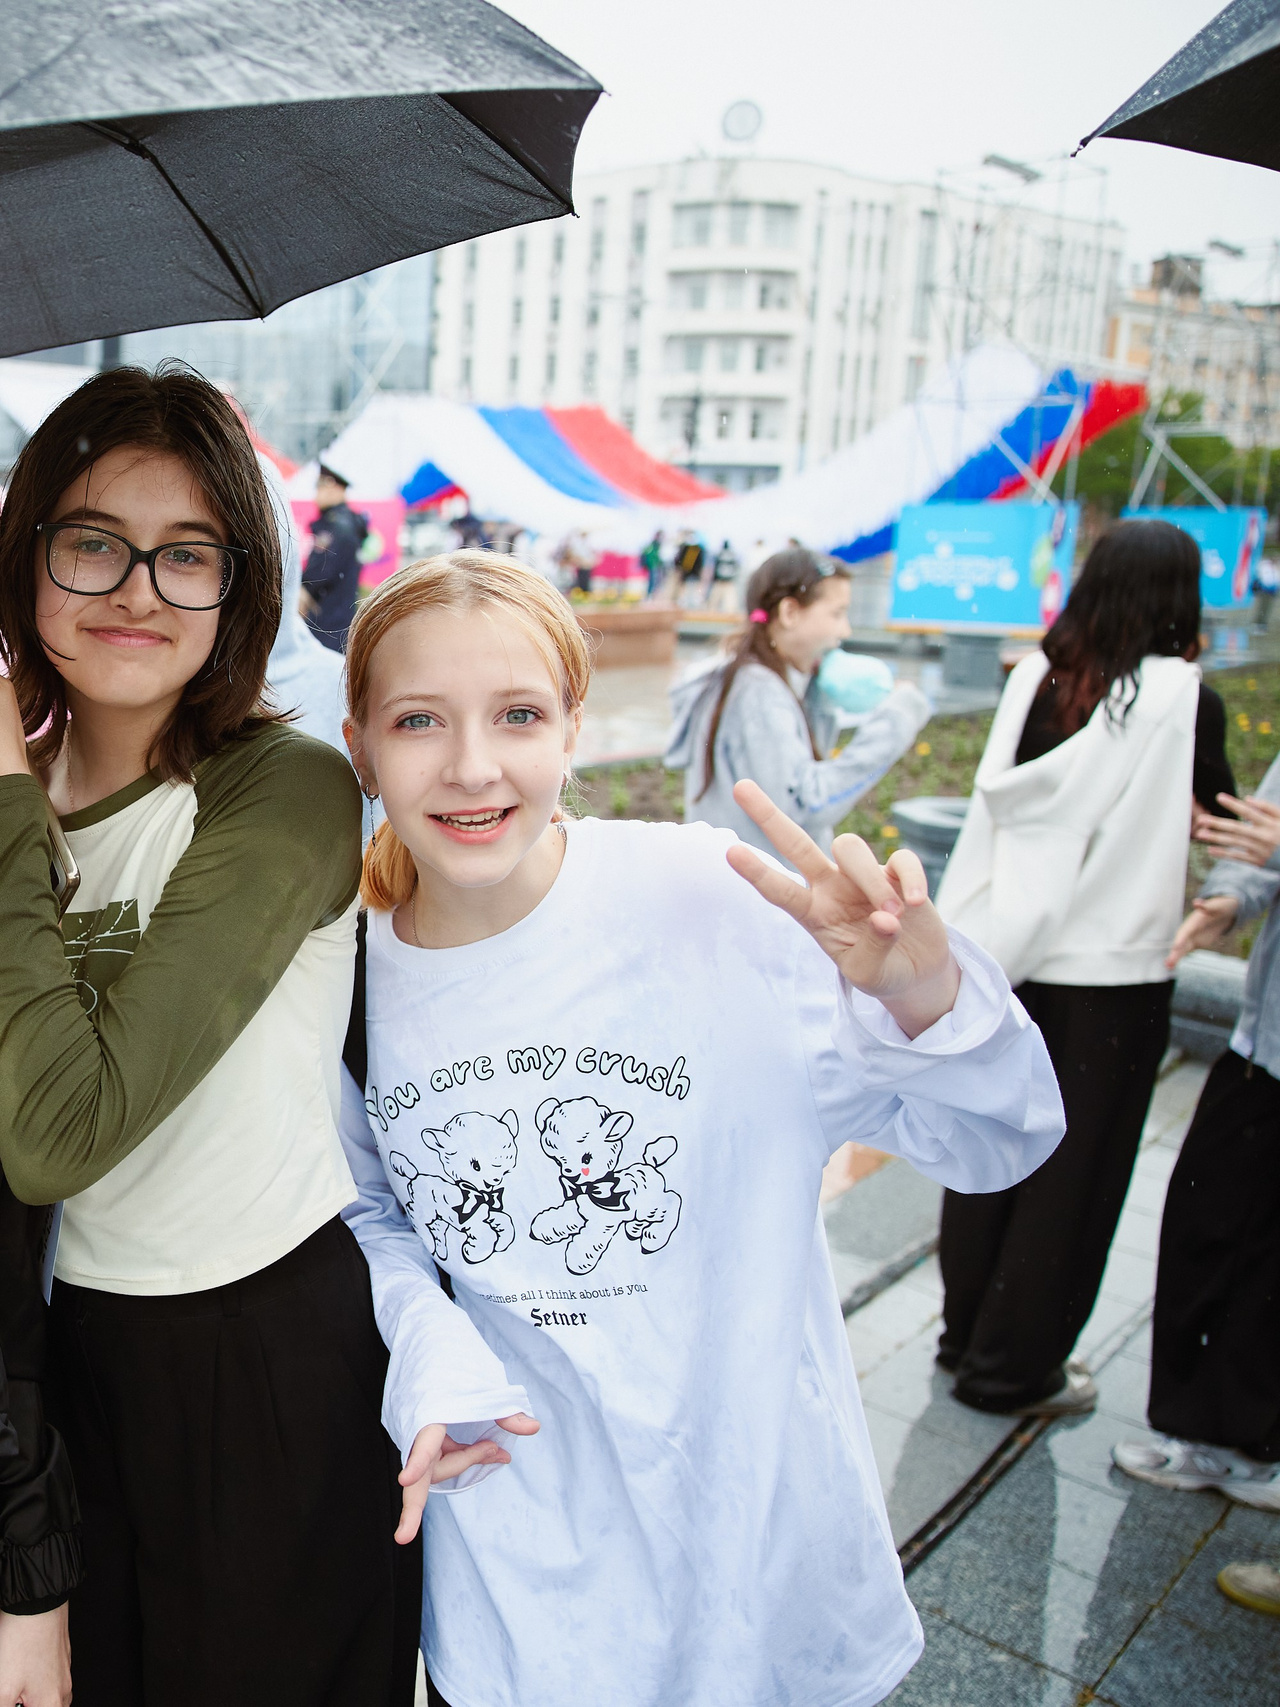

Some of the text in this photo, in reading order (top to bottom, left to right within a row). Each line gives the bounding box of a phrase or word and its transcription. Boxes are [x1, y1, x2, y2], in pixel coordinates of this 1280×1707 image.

[365, 1045, 691, 1132] You are my crush
[521, 1290, 536, 1301] all
[538, 1290, 544, 1299] I
[546, 1289, 577, 1300] think
[579, 1288, 611, 1300] about
[613, 1286, 624, 1296] is
[627, 1283, 648, 1295] you
